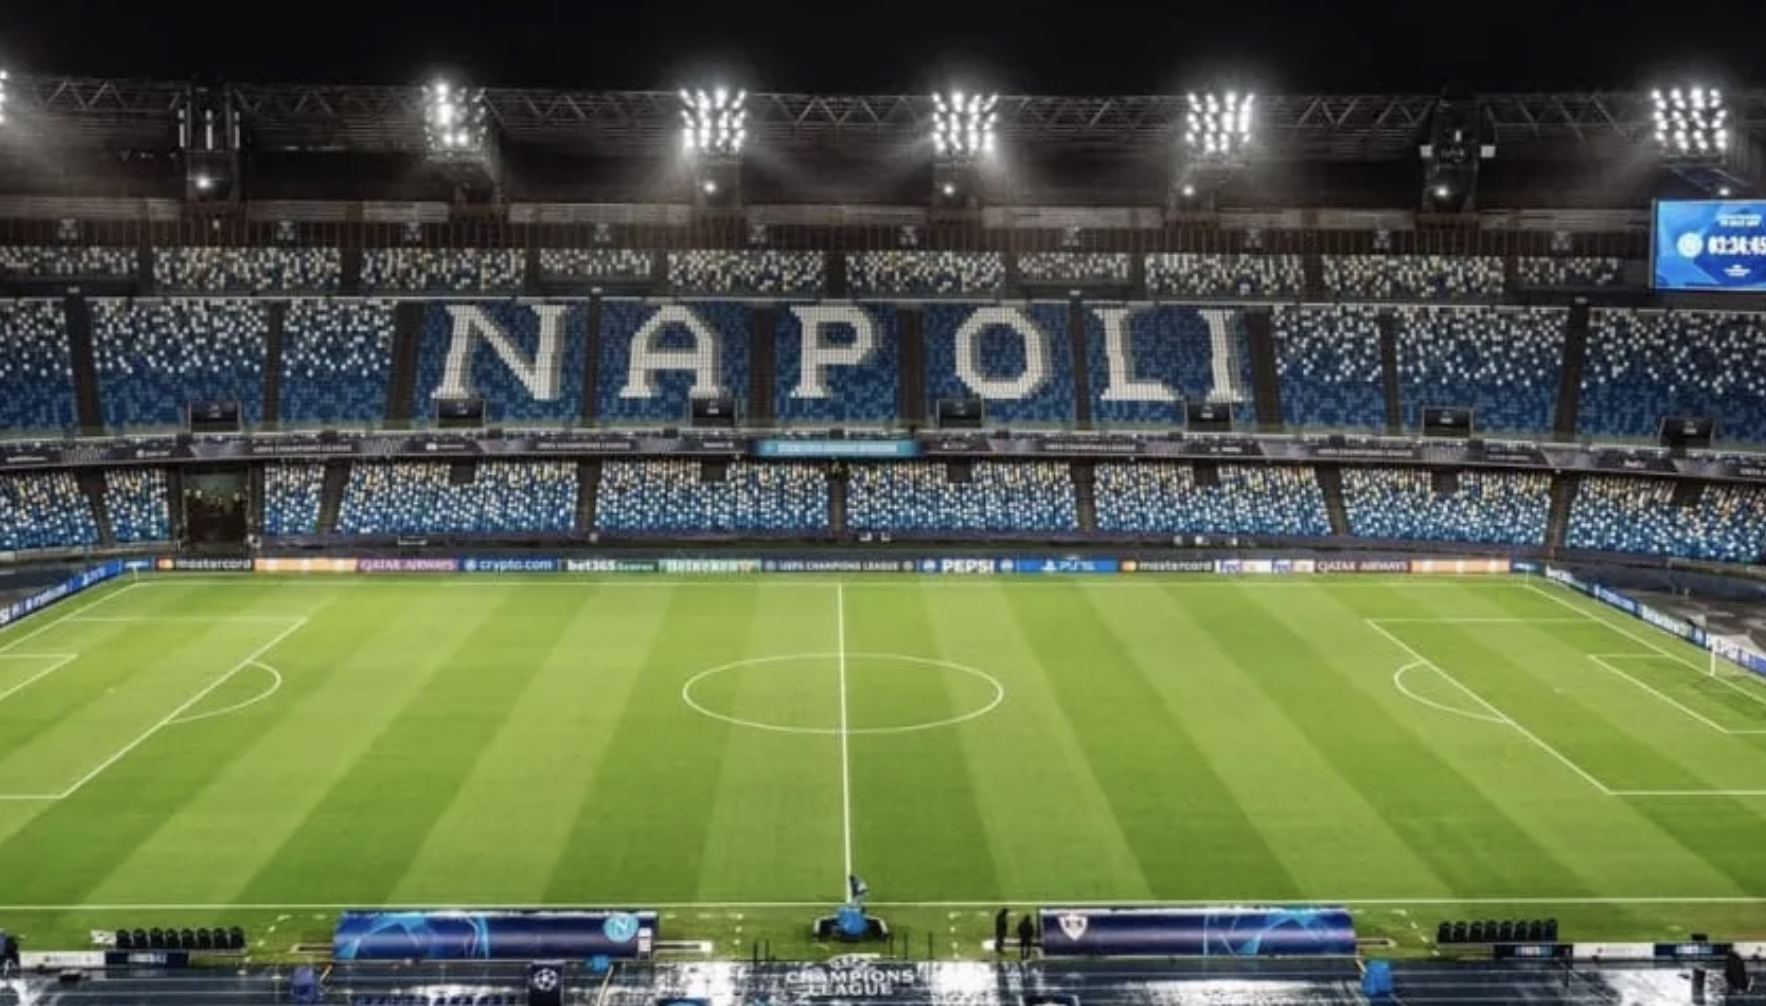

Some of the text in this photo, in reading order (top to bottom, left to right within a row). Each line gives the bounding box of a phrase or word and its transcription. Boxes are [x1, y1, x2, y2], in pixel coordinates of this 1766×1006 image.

[431, 304, 1243, 402] NAPOLI
[942, 558, 995, 573] PEPSI
[808, 982, 893, 996] LEAGUE
